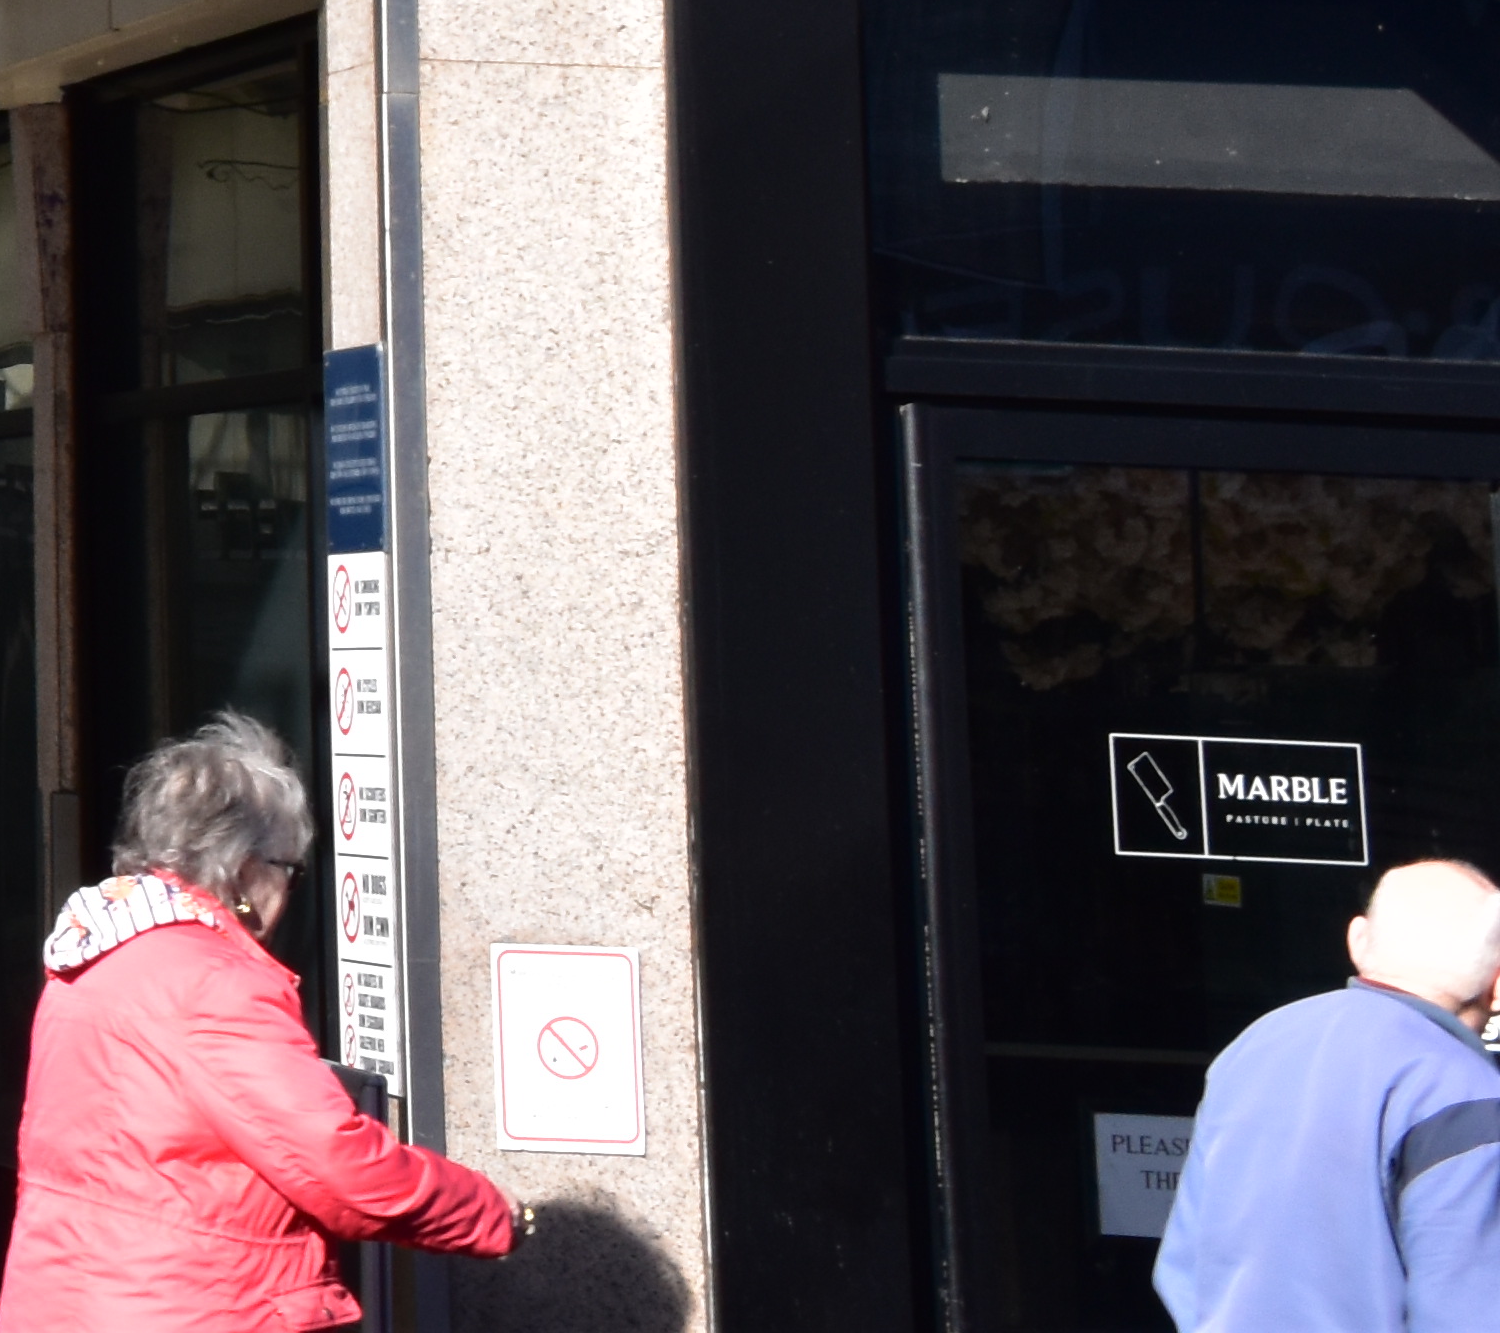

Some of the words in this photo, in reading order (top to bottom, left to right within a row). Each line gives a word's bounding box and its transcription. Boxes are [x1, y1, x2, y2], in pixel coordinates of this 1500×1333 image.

[1216, 772, 1349, 805] MARBLE
[1305, 817, 1349, 829] PLATE
[1111, 1134, 1191, 1157] PLEAS
